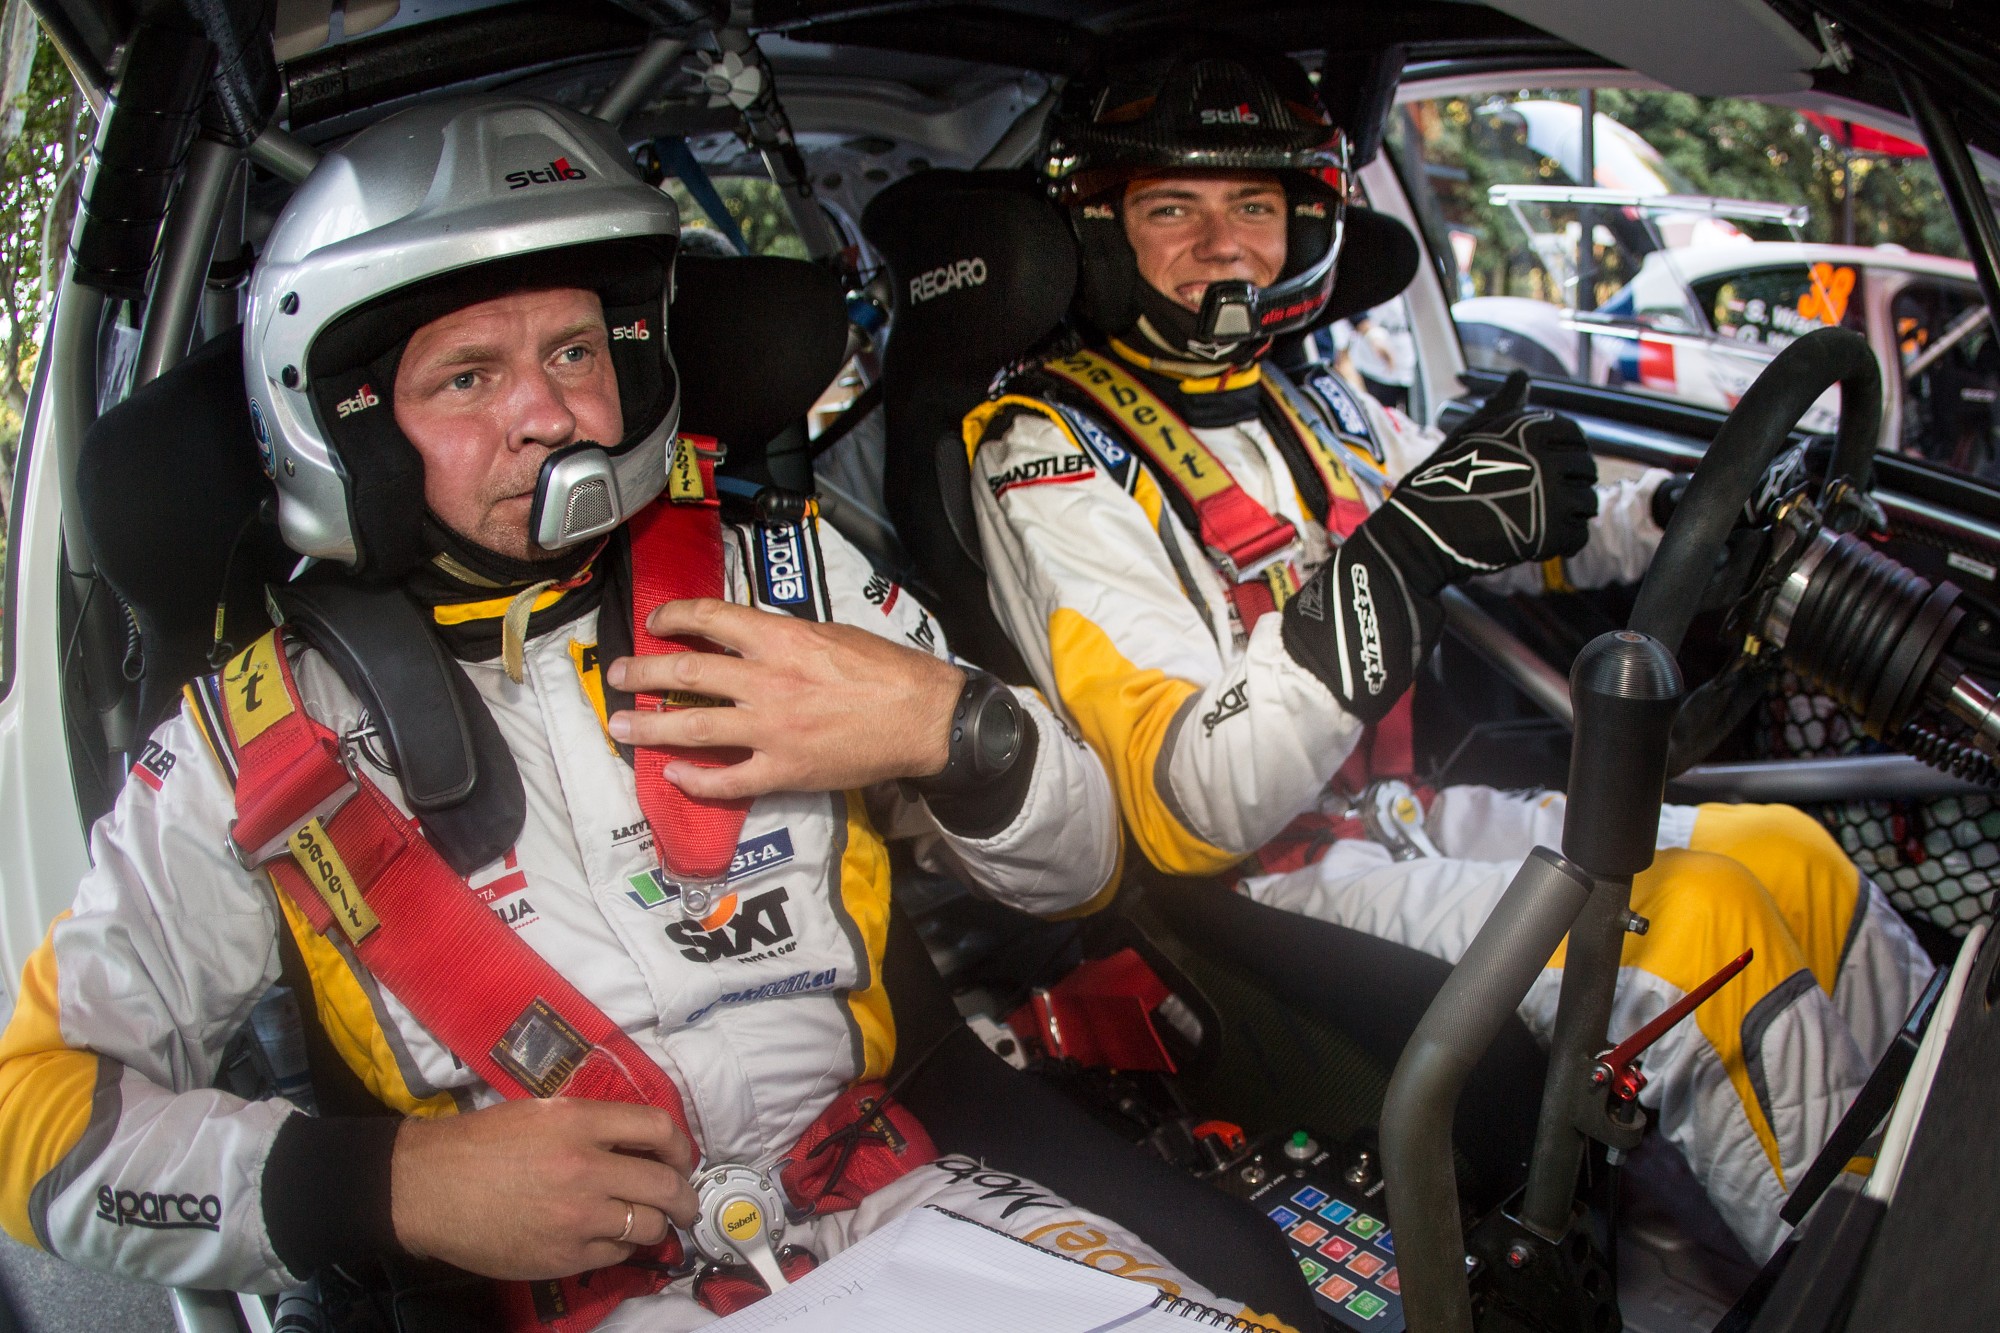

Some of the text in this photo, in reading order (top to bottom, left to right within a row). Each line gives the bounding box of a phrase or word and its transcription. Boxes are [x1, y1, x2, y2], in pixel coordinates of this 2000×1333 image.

[505, 157, 587, 190] Stilo
[910, 257, 988, 305] RECARO
[613, 319, 650, 341] Stilo
[336, 383, 380, 419] Stilo
[297, 825, 362, 928] Sabelt
[664, 886, 793, 963] SIXT
[737, 952, 767, 964] rent
[779, 941, 797, 955] car
[96, 1184, 221, 1230] sparco
[727, 1211, 757, 1232] Sabelt
